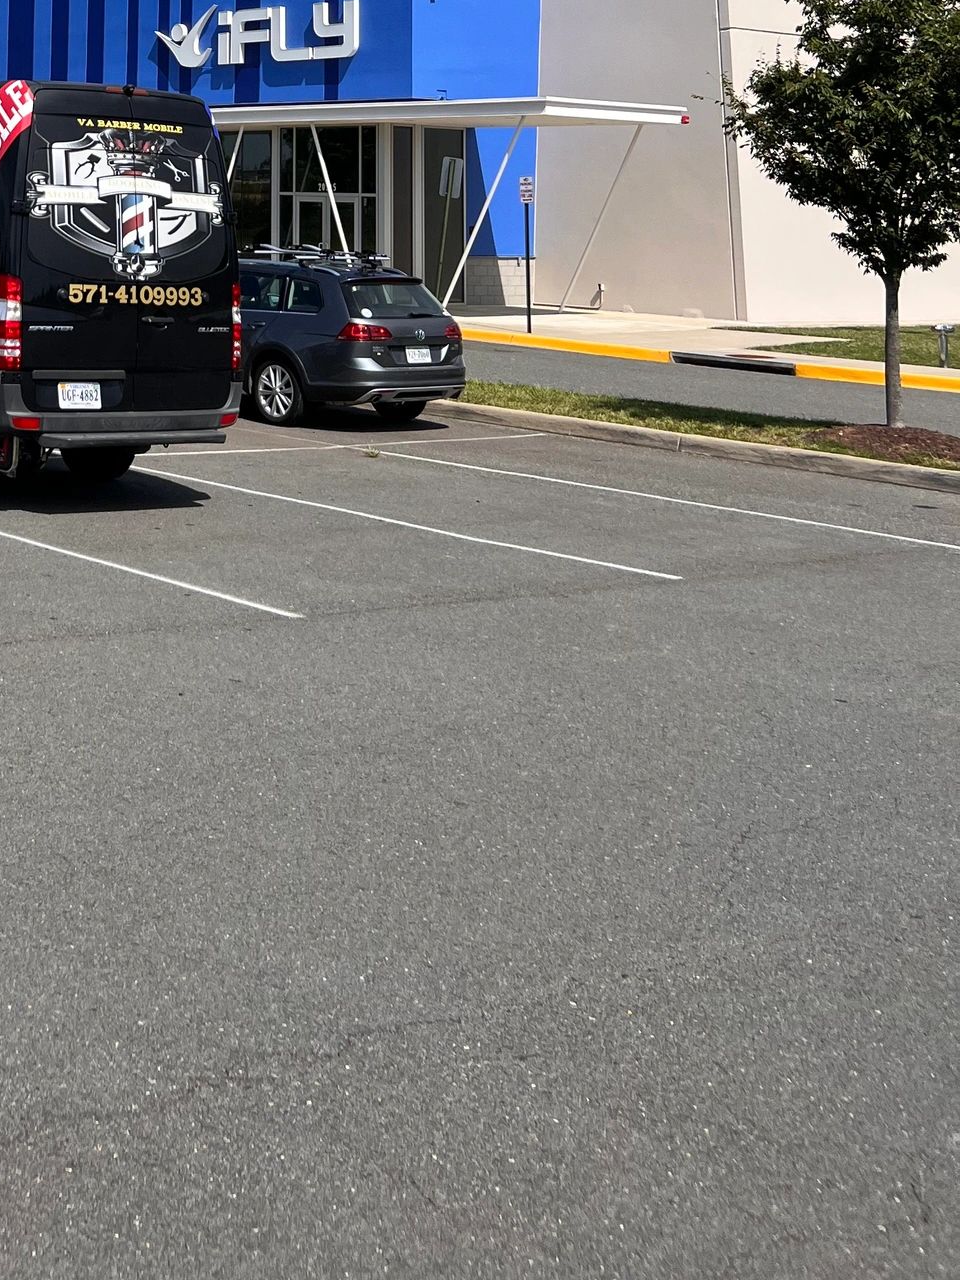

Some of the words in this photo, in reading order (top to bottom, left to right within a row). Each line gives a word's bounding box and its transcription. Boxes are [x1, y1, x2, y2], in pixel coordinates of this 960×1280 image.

[217, 0, 360, 65] iFLY
[77, 118, 94, 127] VA
[97, 119, 141, 130] BARBER
[143, 122, 183, 134] MOBILE
[68, 284, 202, 306] 571-4109993
